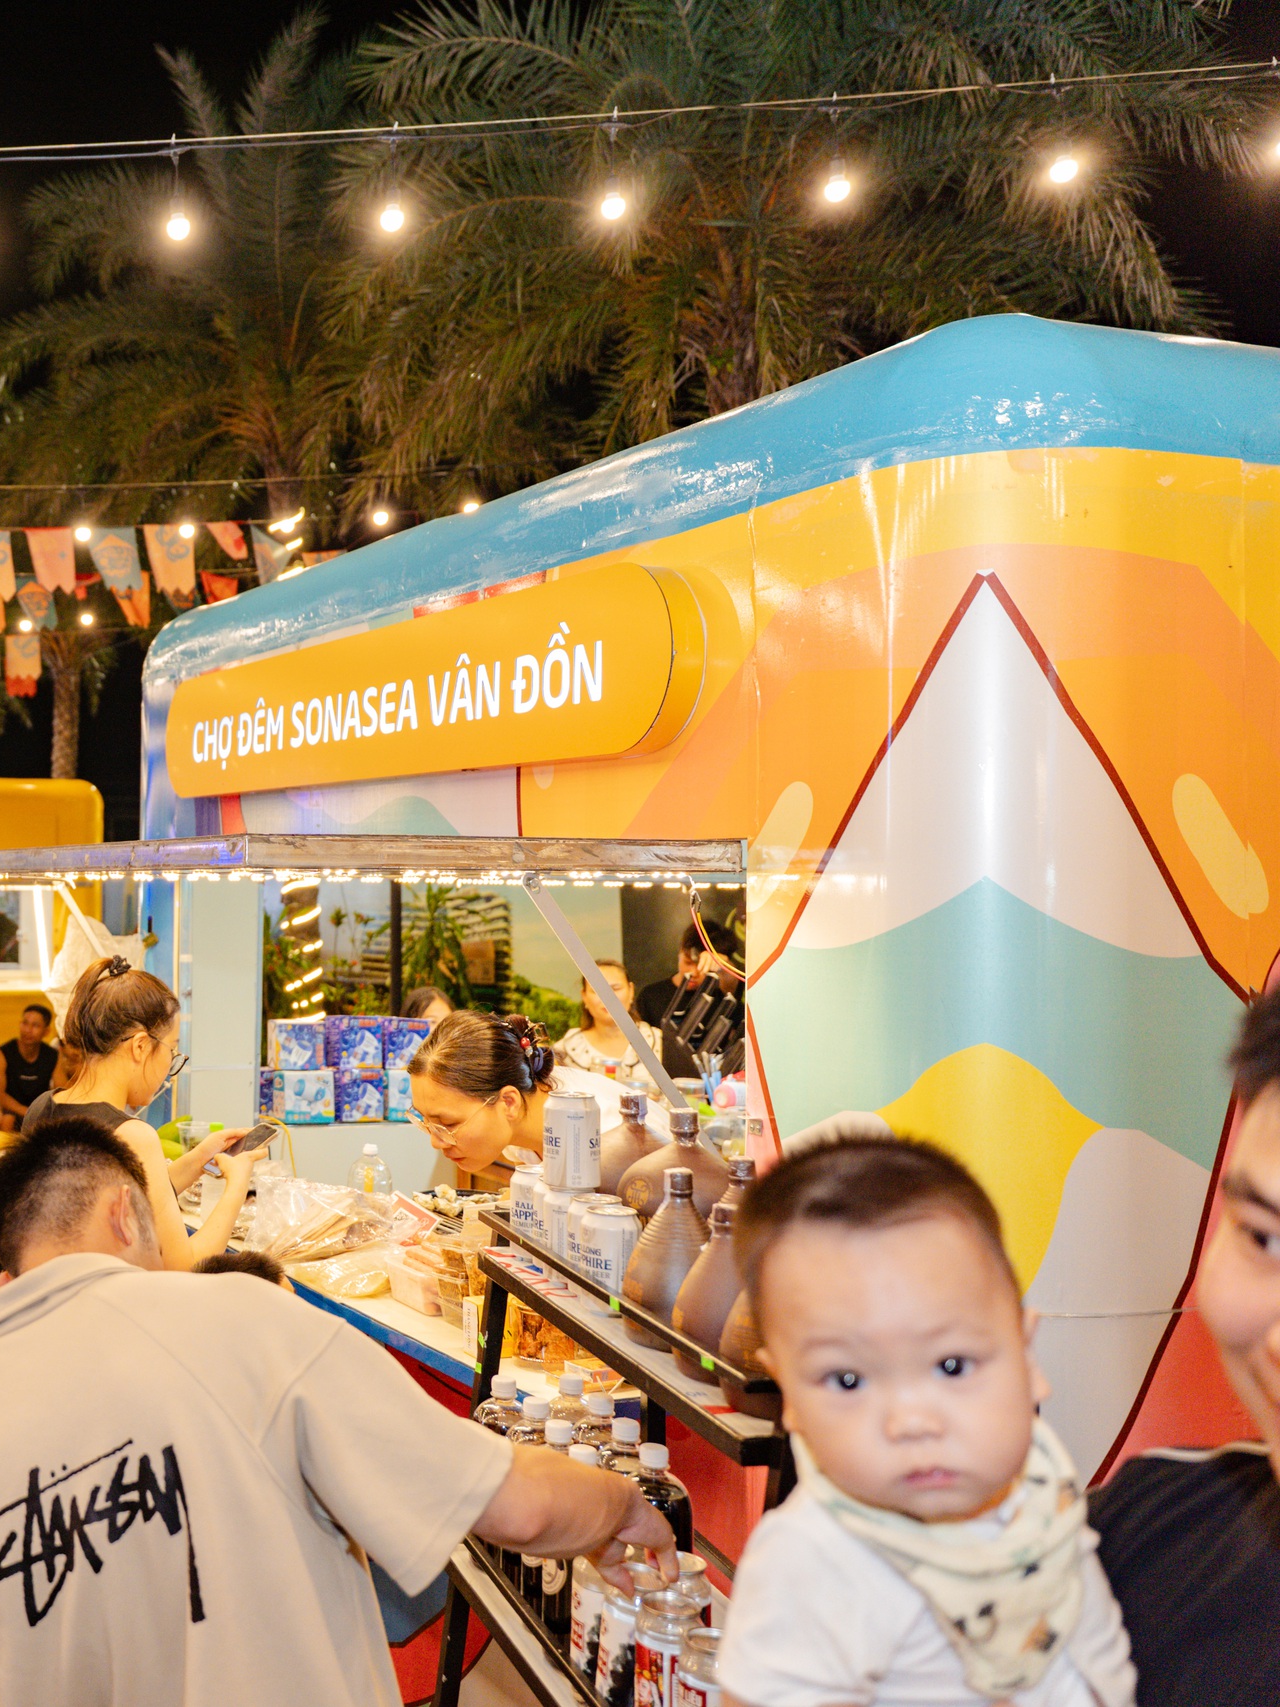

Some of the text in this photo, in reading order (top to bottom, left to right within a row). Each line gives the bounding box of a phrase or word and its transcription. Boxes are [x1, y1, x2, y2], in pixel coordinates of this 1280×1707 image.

[192, 621, 603, 770] CHỢ ĐÊM SONASEA VÂN ĐỒN
